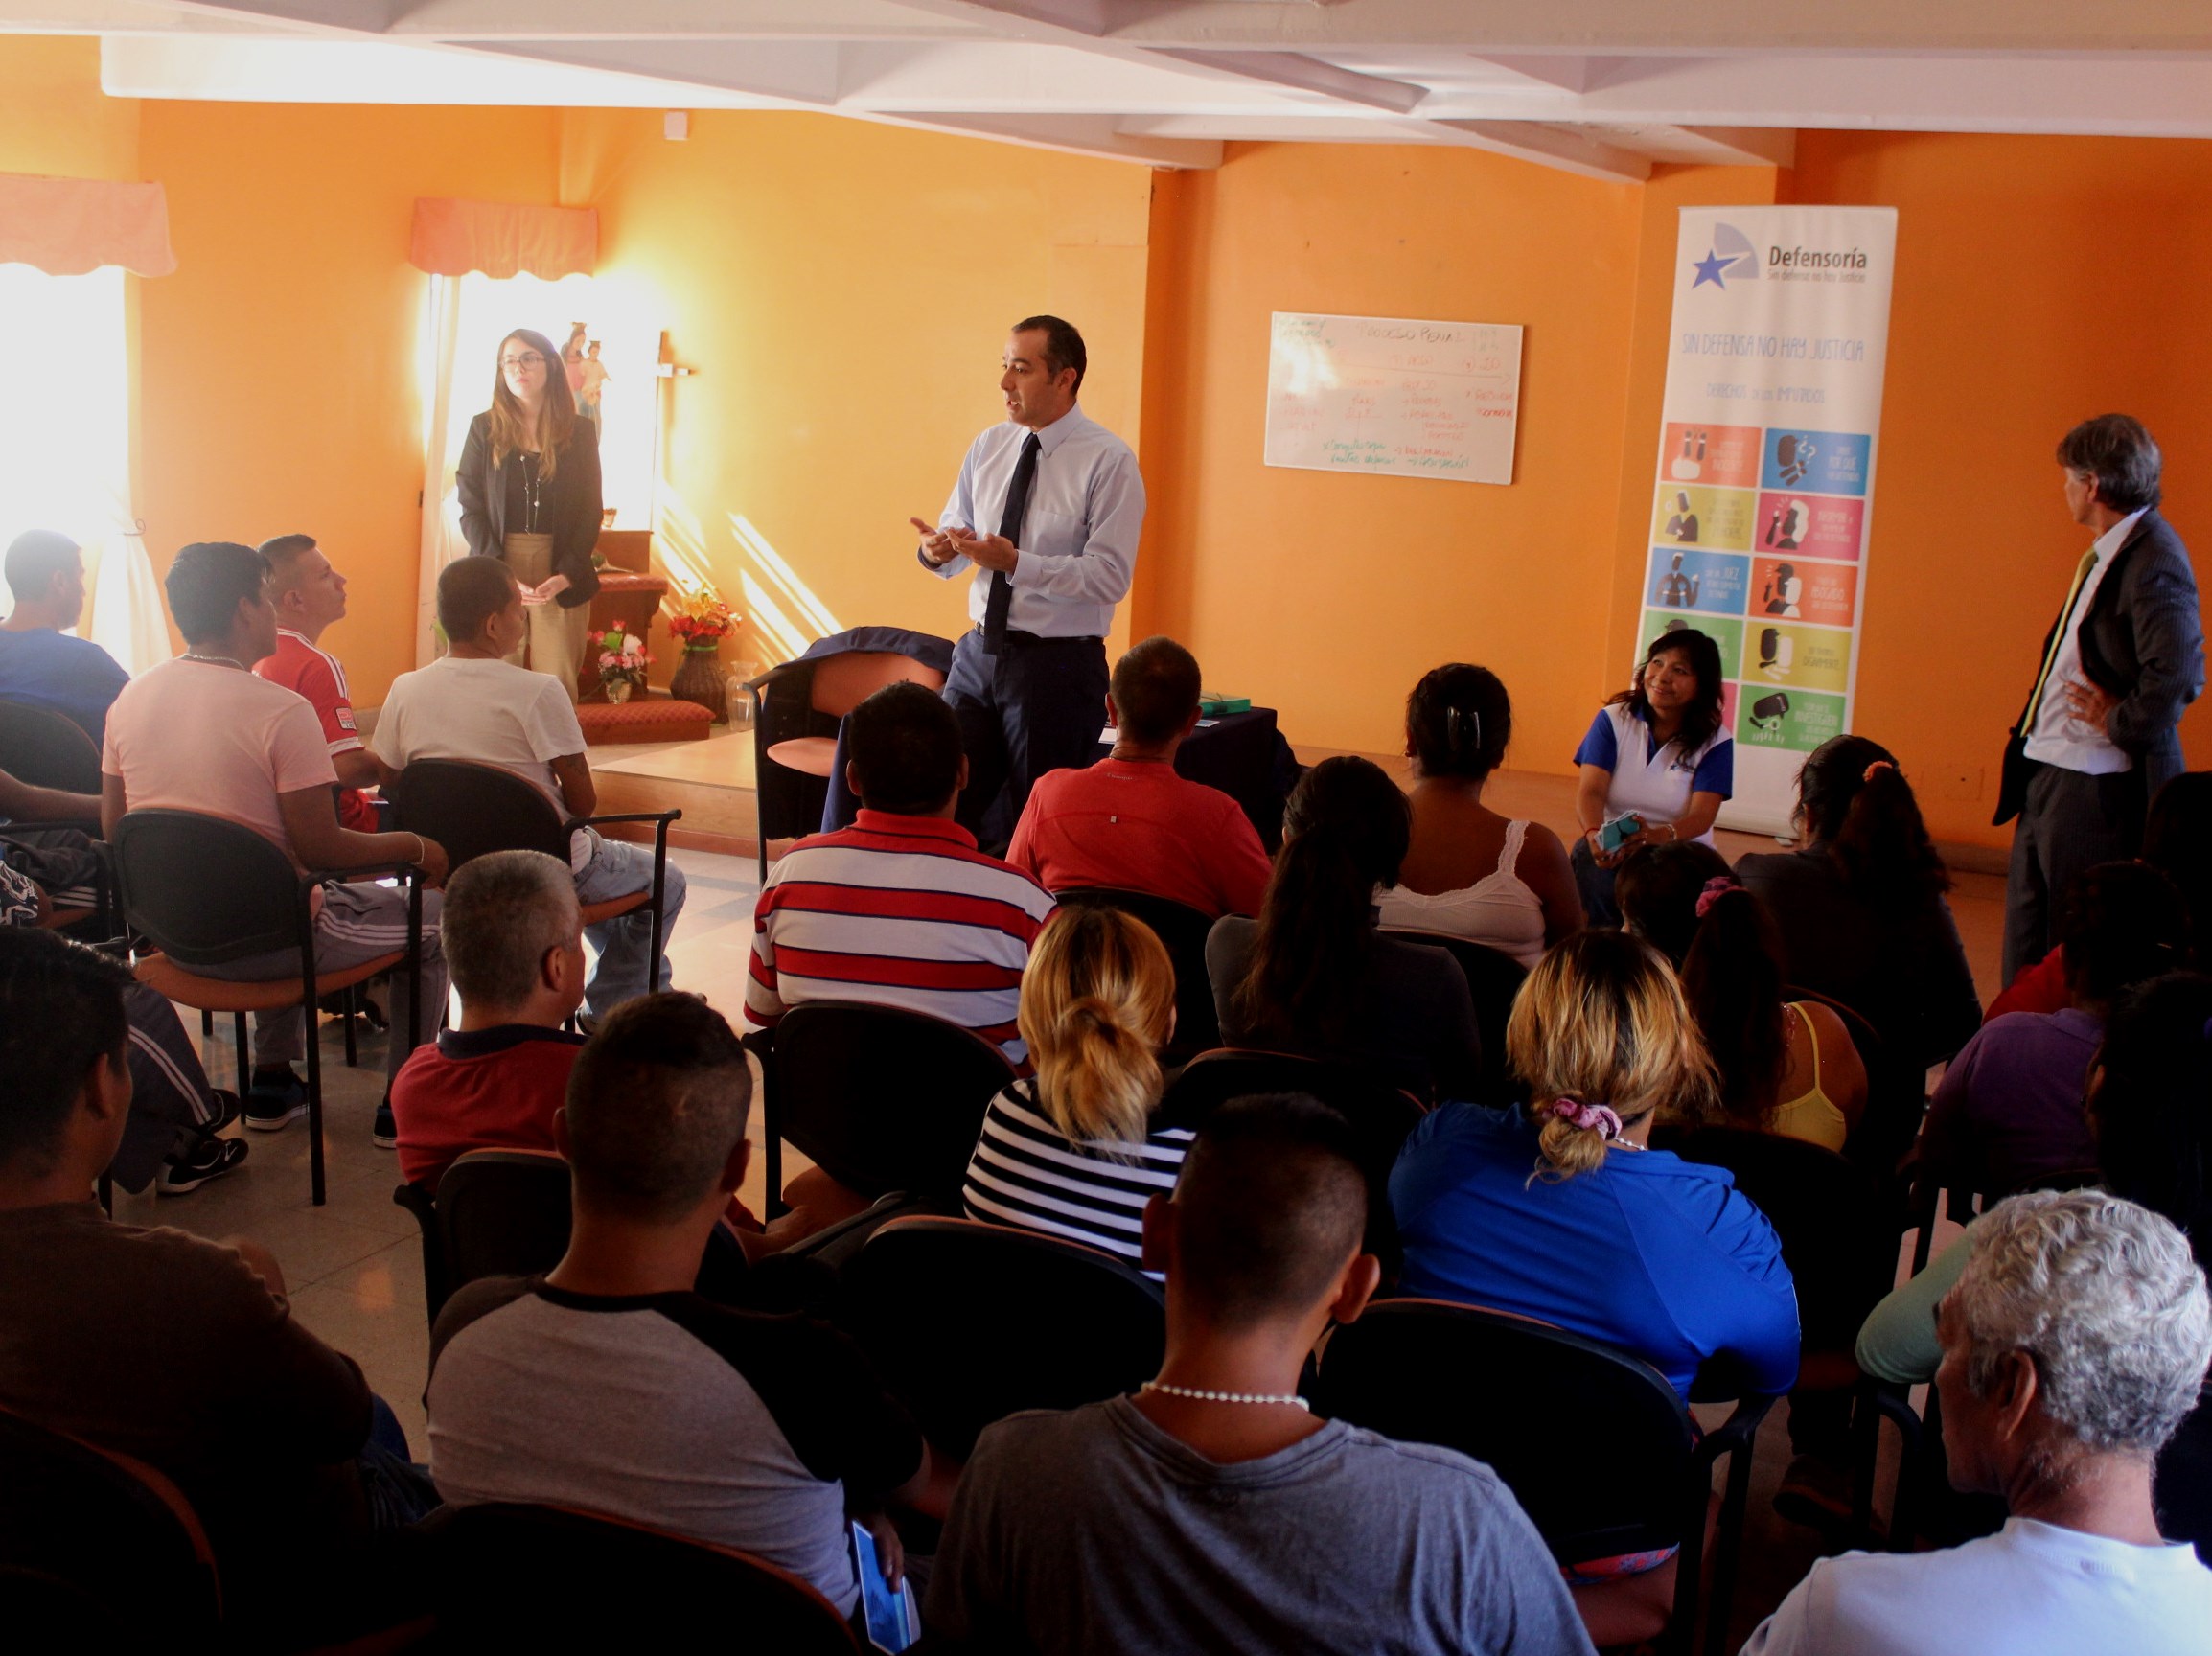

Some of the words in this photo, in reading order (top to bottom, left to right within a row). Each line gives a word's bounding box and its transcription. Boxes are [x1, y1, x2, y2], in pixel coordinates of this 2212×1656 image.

[1769, 245, 1867, 268] Defensoría
[1682, 333, 1699, 355] SIN
[1701, 334, 1755, 357] DEFENSA
[1757, 335, 1778, 358] NO
[1780, 336, 1807, 359] HAY
[1809, 338, 1865, 362] JUSTICIA
